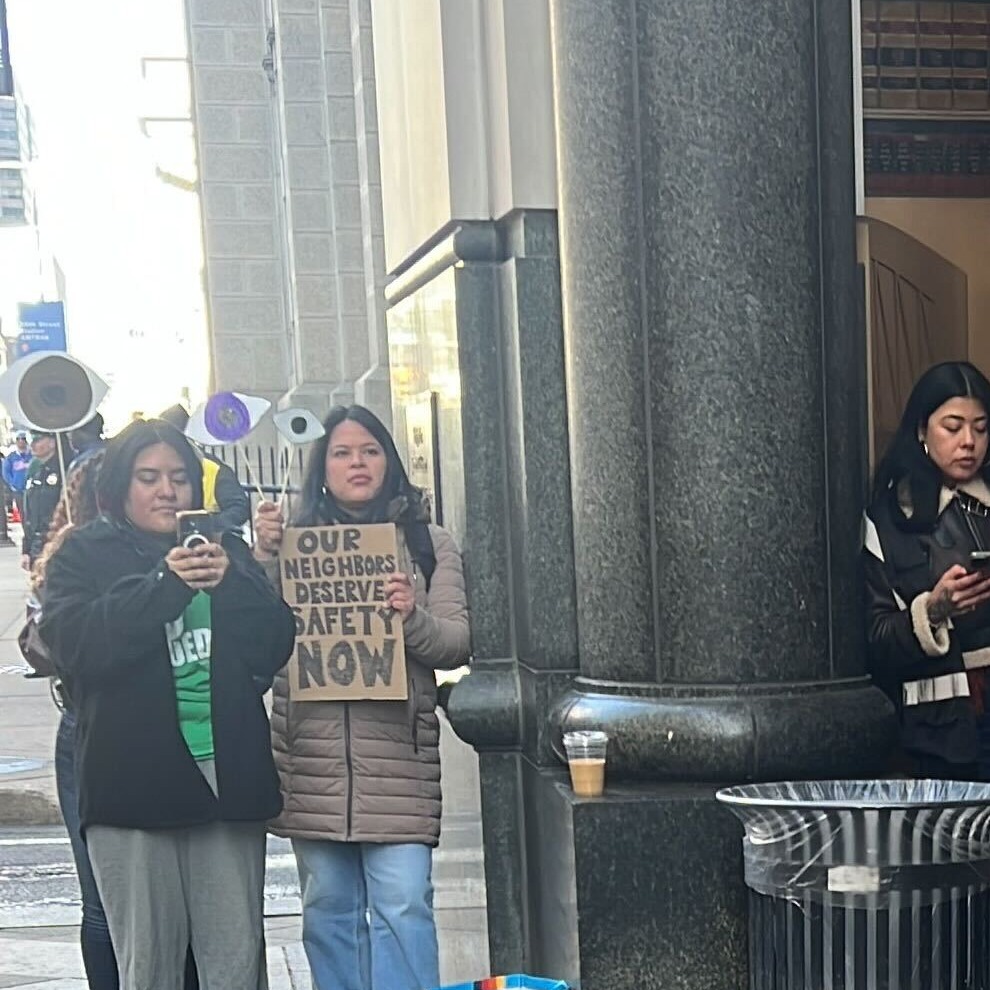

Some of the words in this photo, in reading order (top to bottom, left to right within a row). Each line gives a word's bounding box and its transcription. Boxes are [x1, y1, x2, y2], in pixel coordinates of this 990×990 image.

[297, 528, 361, 554] OUR
[284, 554, 396, 580] NEIGHBORS
[295, 580, 385, 604] DESERVE
[291, 606, 399, 637] SAFETY
[297, 640, 397, 689] NOW
